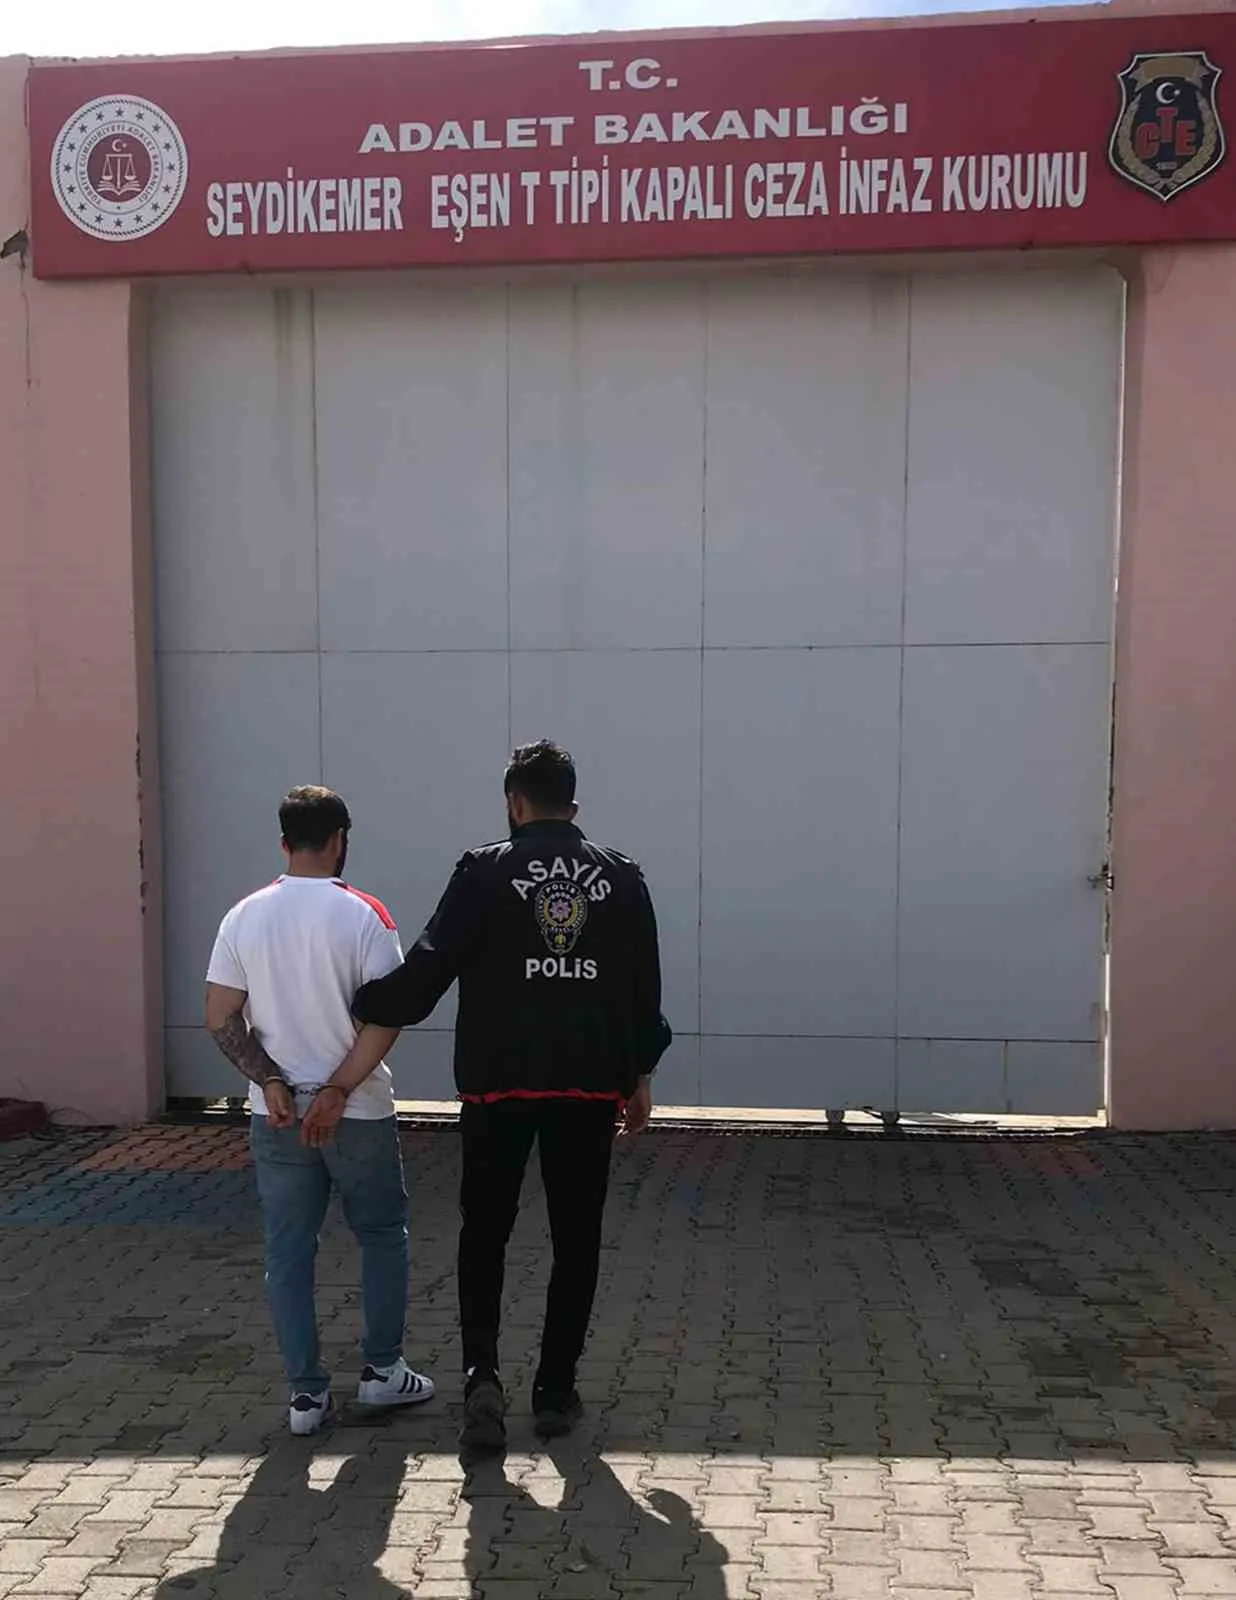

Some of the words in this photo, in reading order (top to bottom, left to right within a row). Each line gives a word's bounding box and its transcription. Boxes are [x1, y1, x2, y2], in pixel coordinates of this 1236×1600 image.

[578, 57, 679, 91] T.C.
[358, 116, 575, 154] ADALET
[594, 96, 909, 146] BAKANLIĞI
[207, 167, 403, 237] SEYDİKEMER
[431, 173, 510, 242] EŞEN
[520, 172, 541, 225] T
[549, 155, 609, 225] TİPİ
[620, 164, 733, 223] KAPALI
[744, 161, 829, 219] CEZA
[839, 146, 933, 215] İNFAZ
[942, 151, 1088, 212] KURUMU
